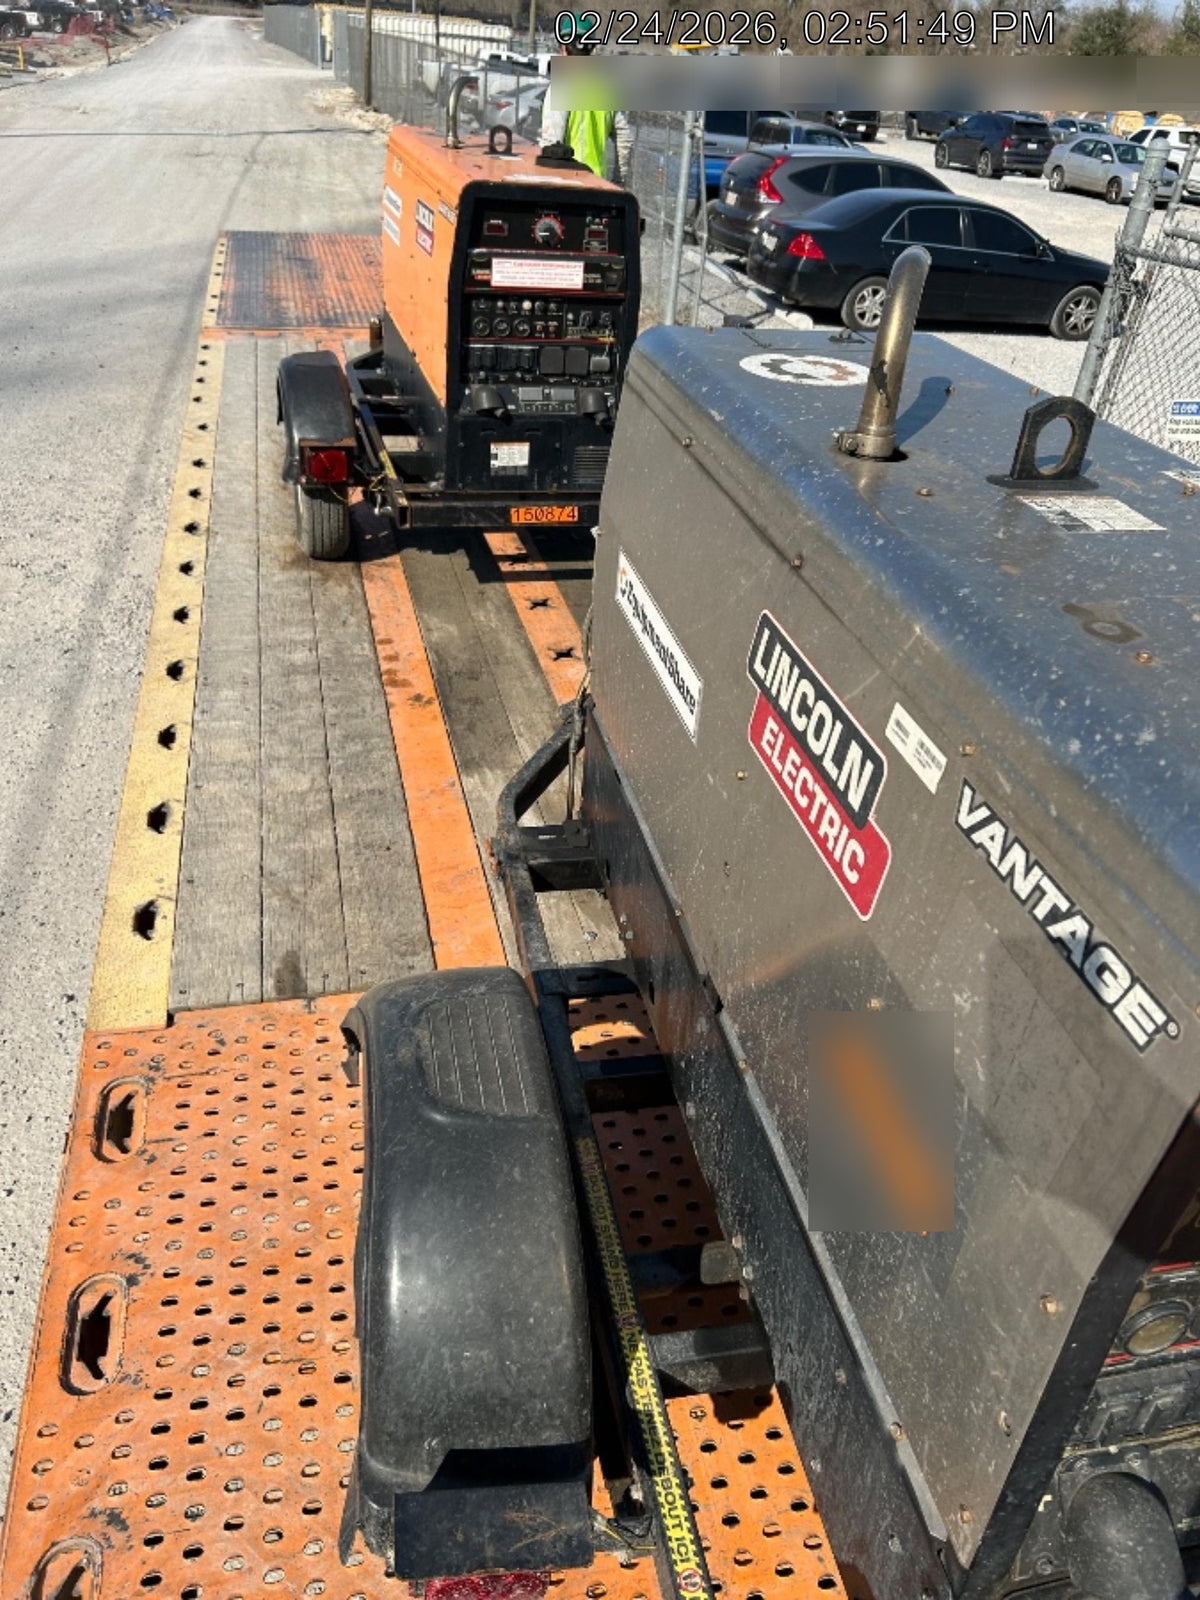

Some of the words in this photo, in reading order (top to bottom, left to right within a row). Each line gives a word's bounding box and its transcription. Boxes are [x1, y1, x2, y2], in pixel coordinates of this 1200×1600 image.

[513, 506, 577, 522] 150874
[753, 627, 874, 813] LINCOLN
[760, 715, 866, 885] ELECTRIC
[955, 778, 1169, 1051] VANTAGE
[591, 1196, 608, 1225] NOT
[600, 1224, 620, 1270] STAND
[610, 1271, 630, 1312] HERE
[625, 1333, 639, 1352] NE
[633, 1358, 649, 1388] PAS
[652, 1452, 685, 1532] DEBOUT
[673, 1533, 692, 1564] ICI
